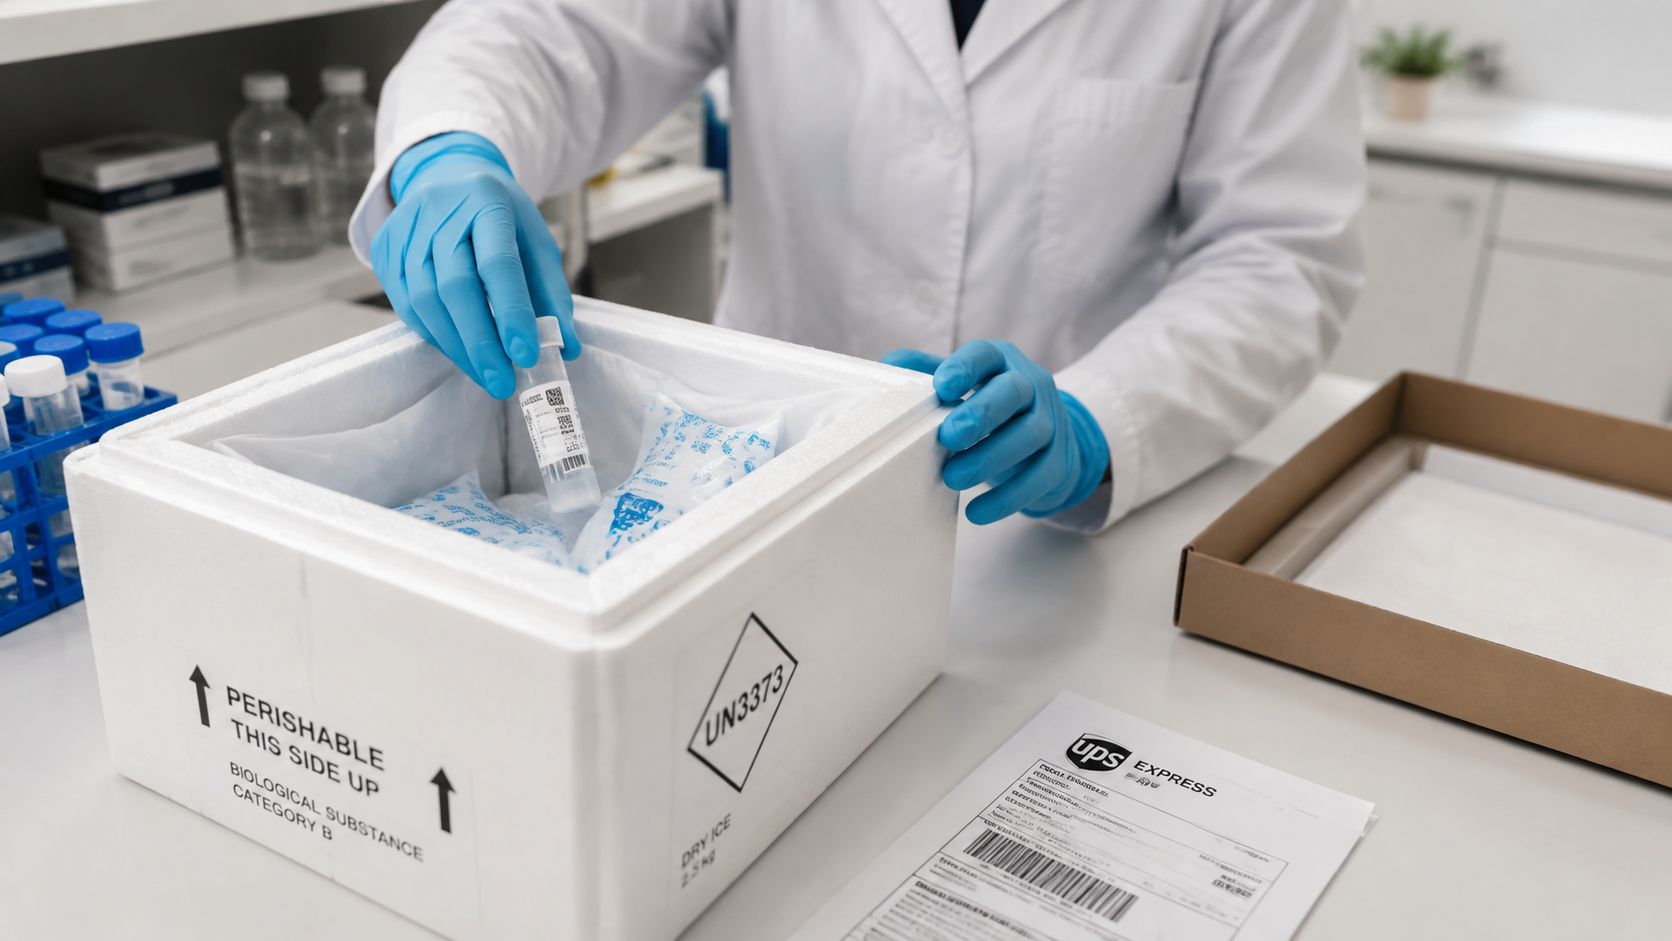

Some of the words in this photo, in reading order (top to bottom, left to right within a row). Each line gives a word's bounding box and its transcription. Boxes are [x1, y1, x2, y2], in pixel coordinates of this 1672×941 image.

[226, 685, 386, 771] PERISHABLE
[705, 664, 784, 747] UN3373
[231, 718, 282, 756] THIS
[288, 744, 341, 783] SIDE
[348, 770, 380, 797] UP
[1133, 760, 1218, 798] EXPRESS
[230, 761, 322, 815] BIOLOGICAL
[325, 806, 424, 862] SUBSTANCE
[233, 783, 316, 833] CATEGORY
[322, 825, 334, 841] B
[682, 832, 709, 869] DRY
[711, 812, 732, 842] ICE
